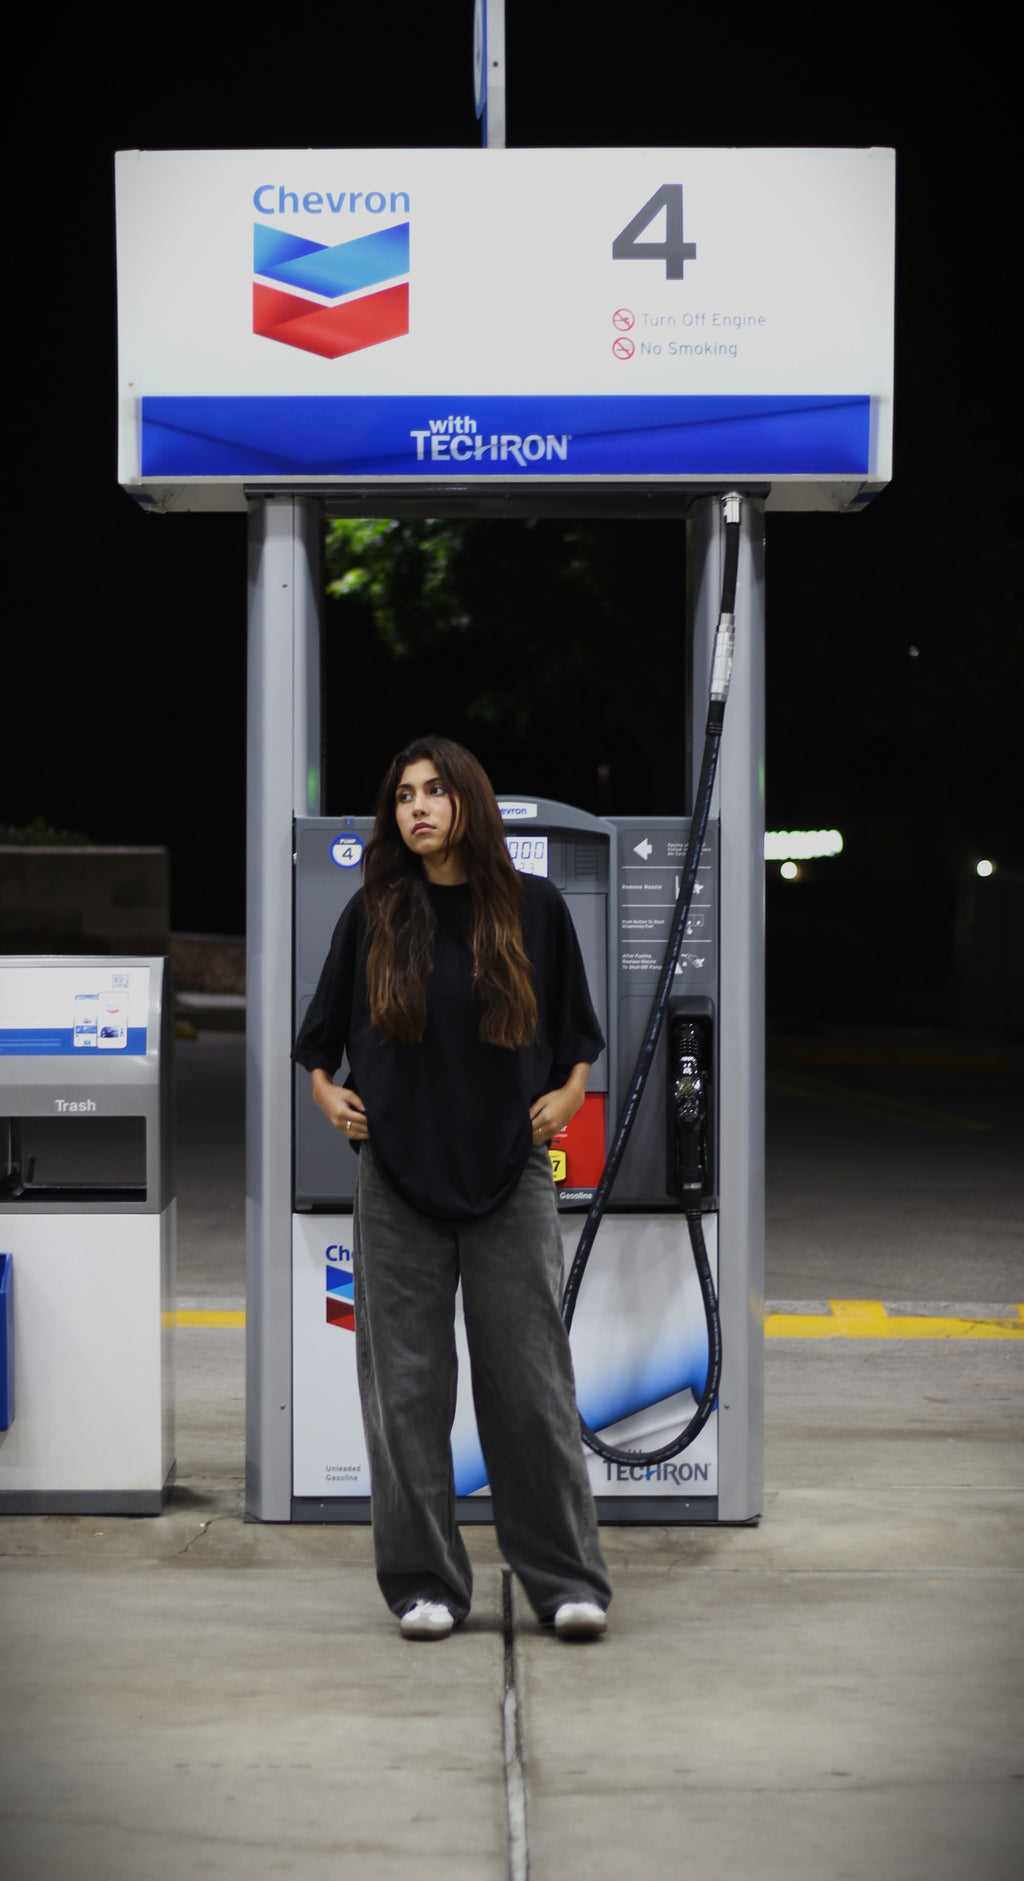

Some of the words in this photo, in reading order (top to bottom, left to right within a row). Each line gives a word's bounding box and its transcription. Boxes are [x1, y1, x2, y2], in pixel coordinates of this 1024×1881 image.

[253, 184, 410, 214] Chevron
[612, 184, 697, 280] 4
[642, 313, 676, 327] Turn
[682, 312, 706, 327] Off
[712, 313, 767, 330] Engine
[640, 342, 662, 356] No
[668, 341, 738, 358] Smoking
[429, 415, 477, 434] with
[410, 430, 567, 466] TECHRON
[342, 847, 353, 860] 4
[55, 1099, 96, 1112] Trash
[553, 1160, 560, 1172] 7
[560, 1191, 593, 1200] Gasoline
[603, 1460, 708, 1485] TECHRON
